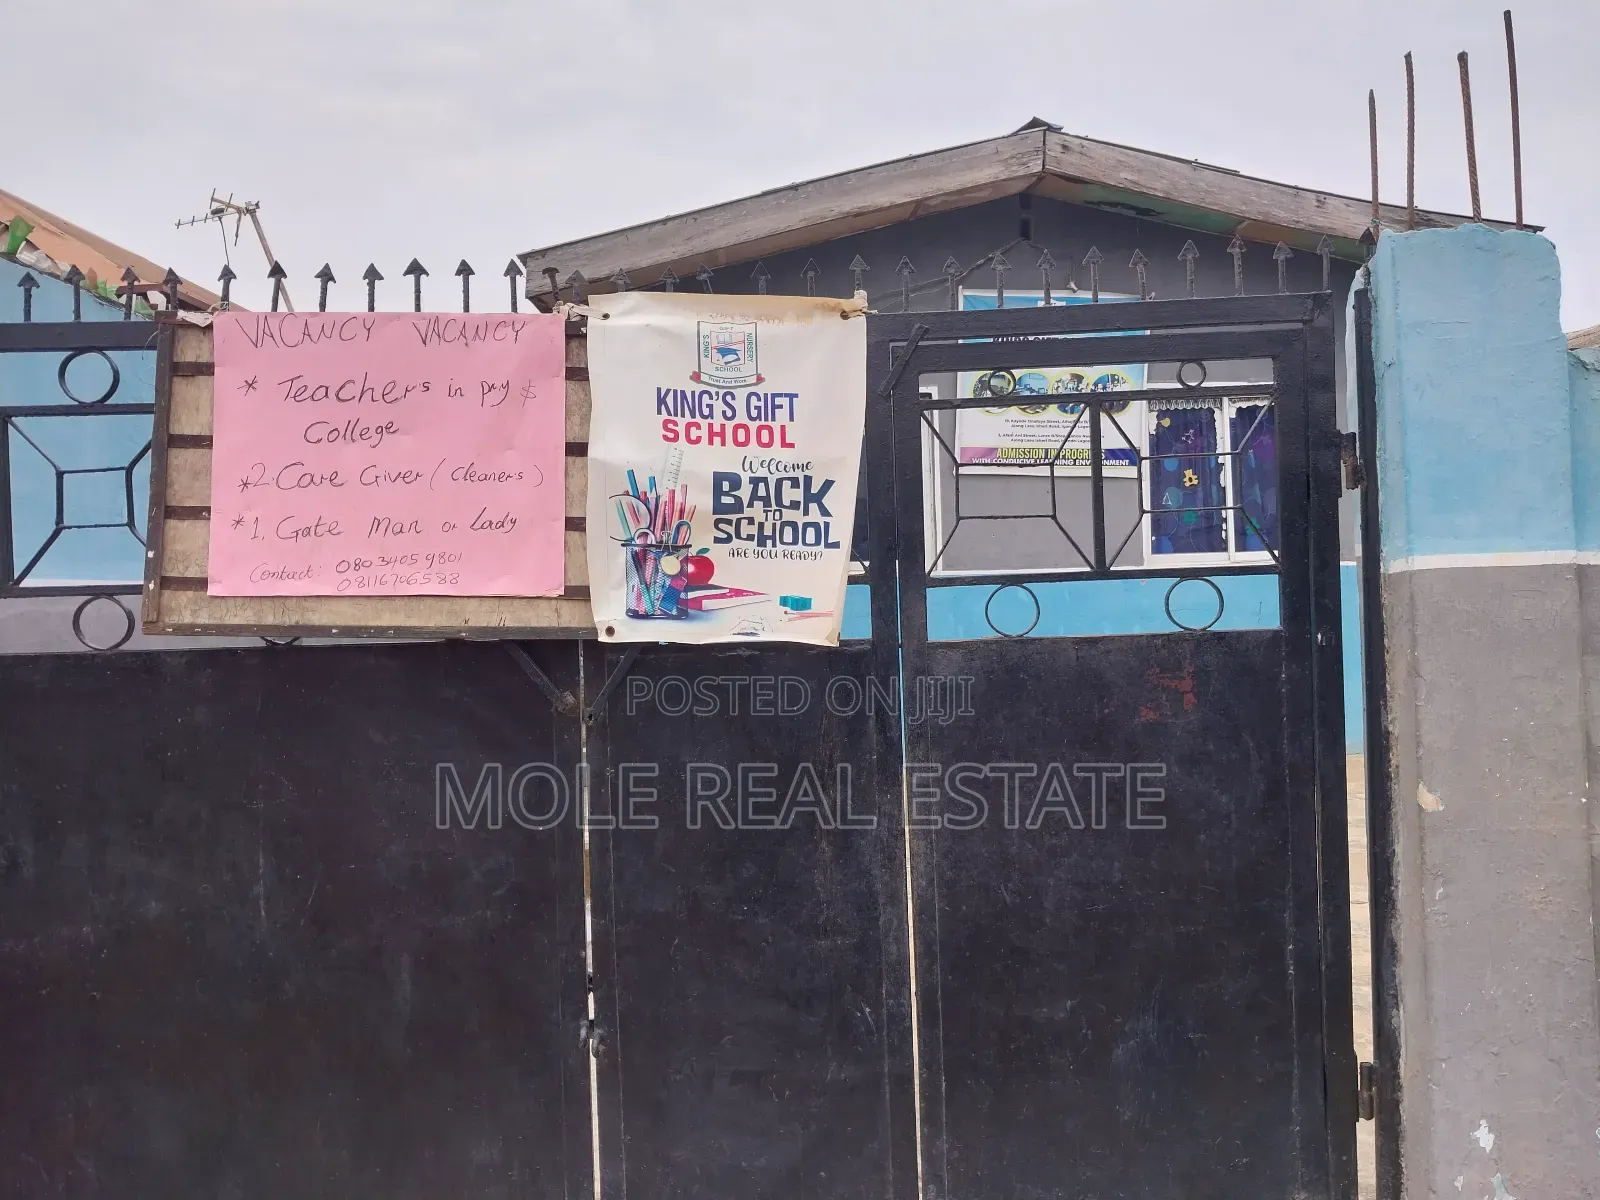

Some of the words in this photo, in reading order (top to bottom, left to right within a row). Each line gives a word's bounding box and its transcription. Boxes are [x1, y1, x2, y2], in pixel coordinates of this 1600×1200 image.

[236, 313, 376, 349] VACANCY
[412, 315, 528, 348] VACANCY
[746, 332, 754, 363] NURSERY
[447, 378, 465, 398] in
[656, 387, 737, 422] KING'S
[745, 391, 799, 423] GIFT
[304, 417, 400, 449] College
[662, 418, 796, 449] SCHOOL
[741, 455, 814, 475] Welcome
[997, 448, 1045, 459] ADMISSION
[1048, 448, 1057, 459] IN
[275, 461, 349, 491] Care
[359, 464, 424, 487] Giver
[712, 471, 836, 518] BACK
[275, 515, 345, 543] Gate
[763, 508, 783, 522] TO
[713, 516, 841, 550] SCHOOL
[728, 547, 750, 559] ARE
[752, 548, 778, 560] YOU
[781, 549, 823, 561] READY?
